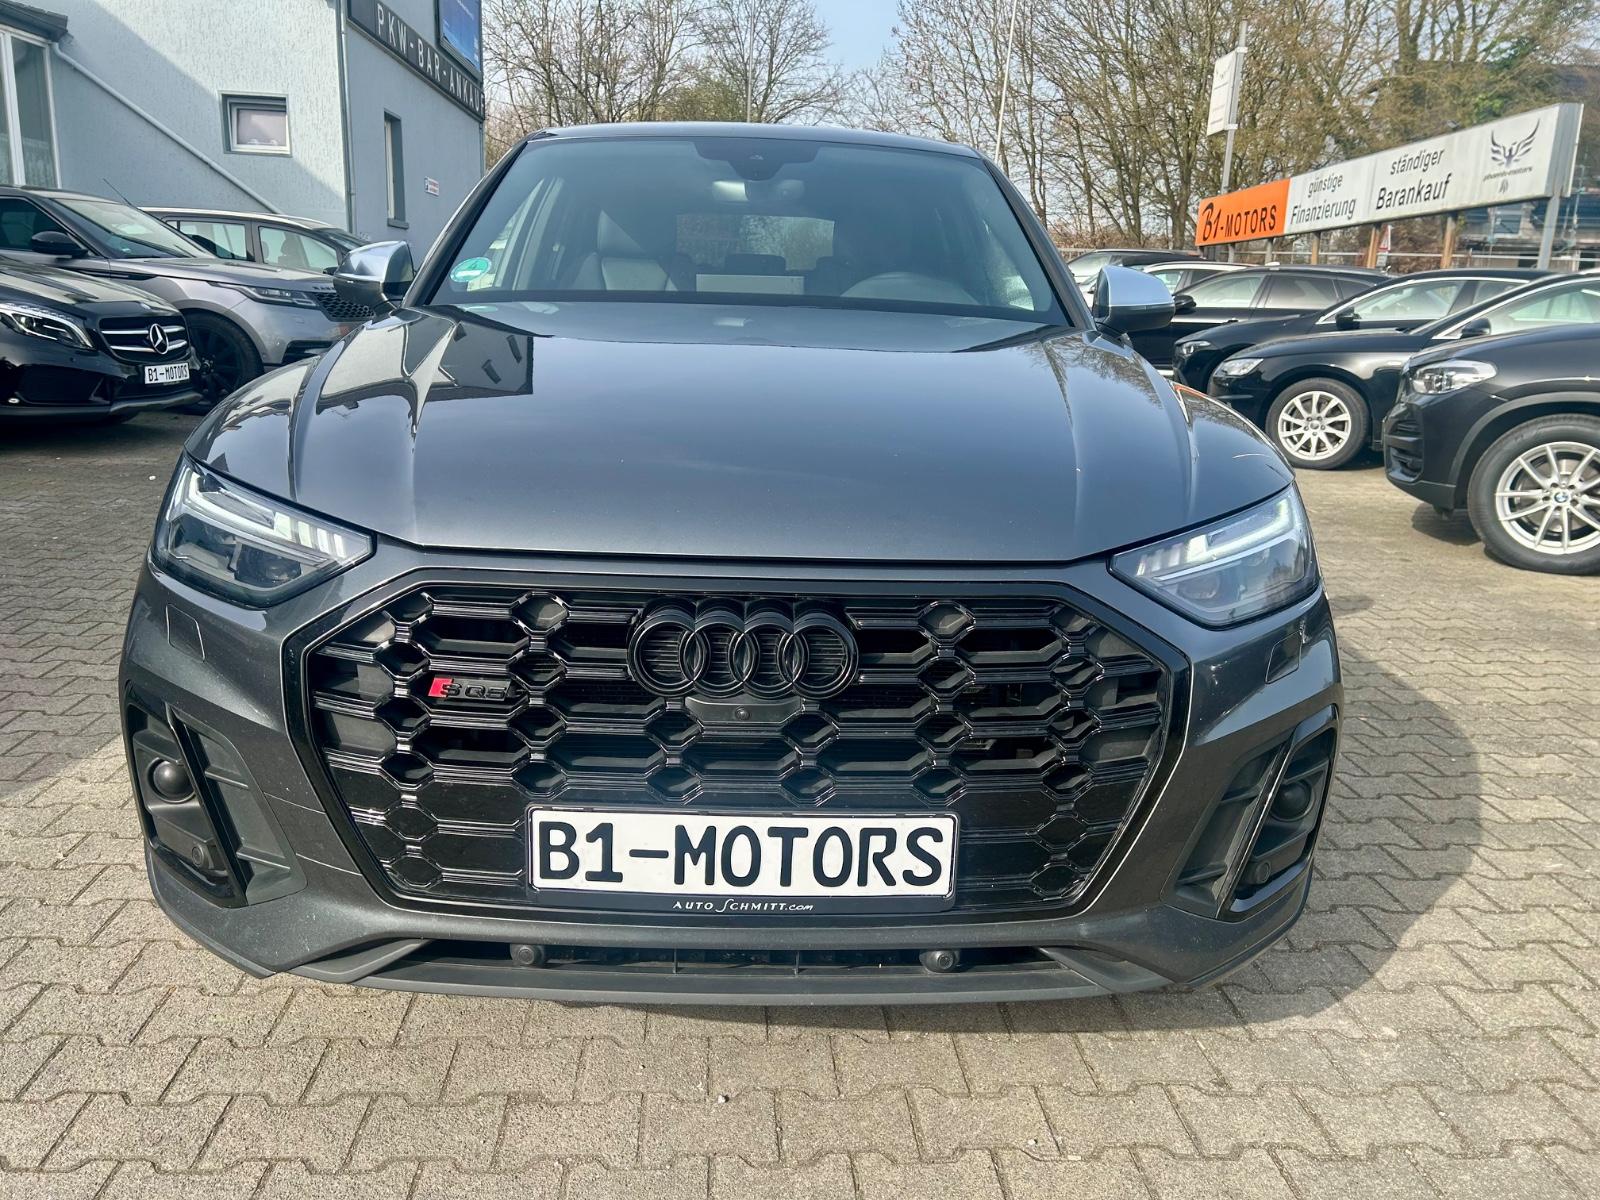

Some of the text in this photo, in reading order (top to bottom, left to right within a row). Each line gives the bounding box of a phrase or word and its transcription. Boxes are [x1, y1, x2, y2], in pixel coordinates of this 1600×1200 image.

[1390, 149, 1445, 175] ständiger
[1308, 174, 1343, 198] günstige
[1376, 173, 1451, 210] Barankauf
[1202, 202, 1277, 242] B1-MOTORS
[1291, 199, 1356, 225] Finanzierung
[147, 364, 188, 382] B1-MOTORS
[440, 682, 507, 700] SQ5
[539, 820, 944, 888] B1-MOTORS
[672, 900, 714, 911] AUTO
